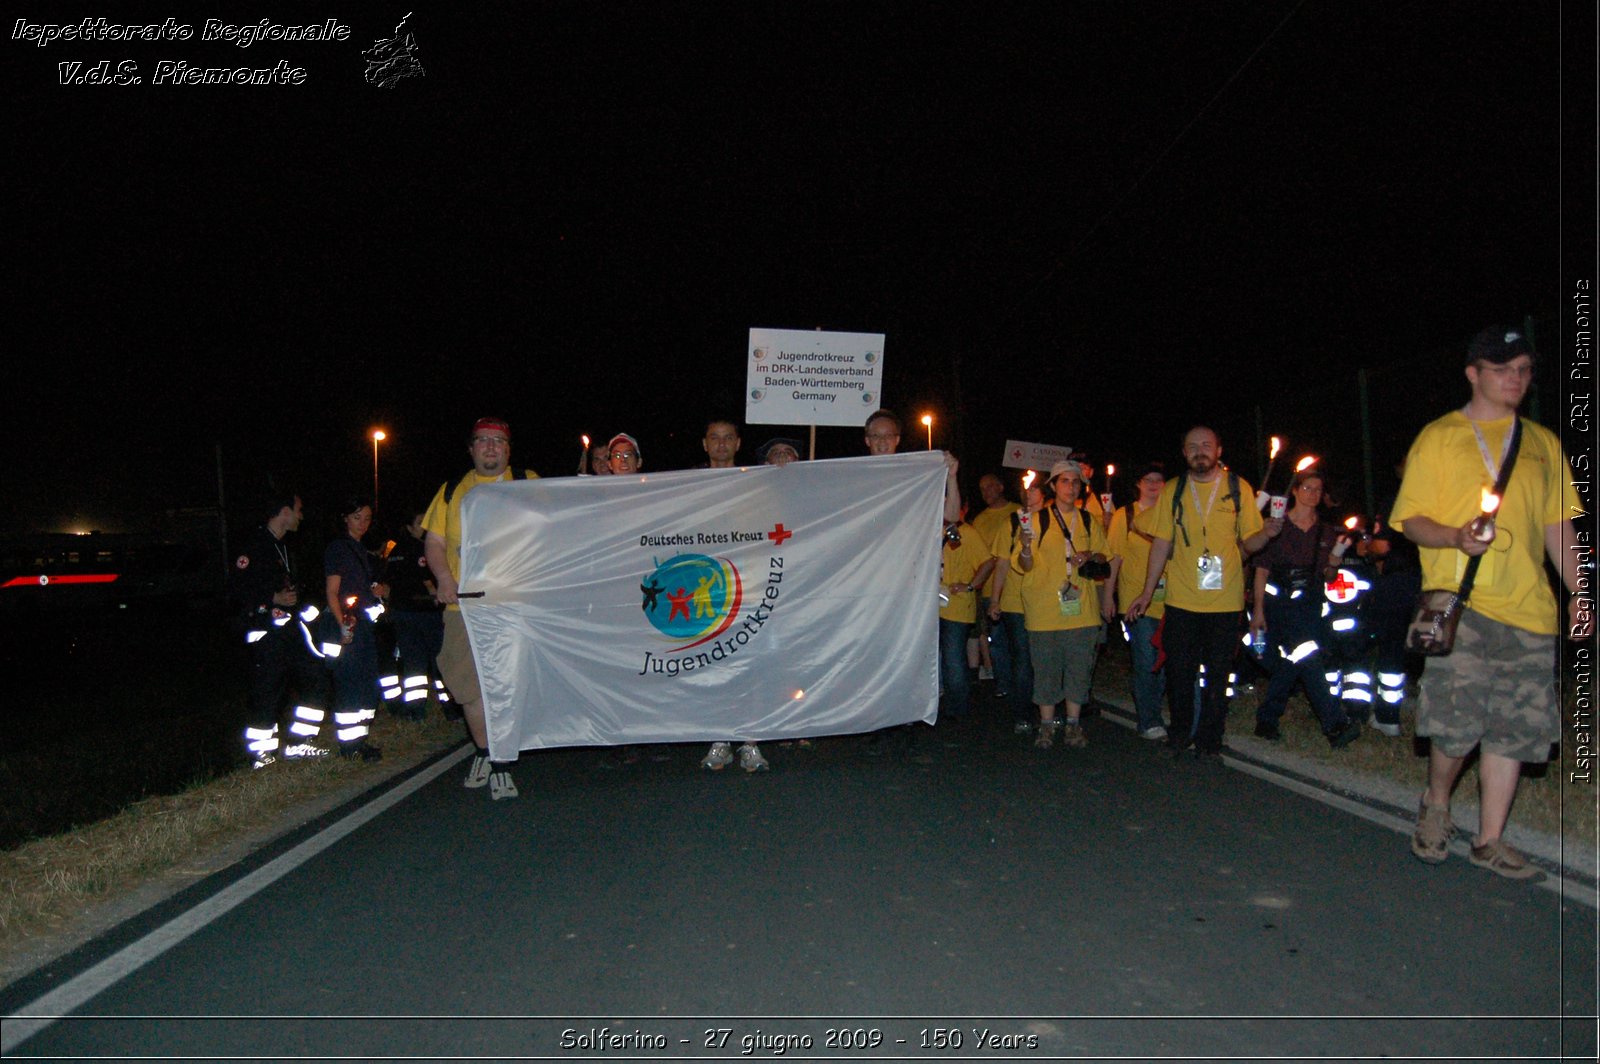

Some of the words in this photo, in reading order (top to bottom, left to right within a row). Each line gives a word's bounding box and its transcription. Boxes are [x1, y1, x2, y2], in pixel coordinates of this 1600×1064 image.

[777, 351, 855, 362] Jugendrotkreuz
[756, 363, 769, 372] im
[771, 364, 874, 376] DRK-Landesverband
[764, 377, 865, 391] Baden-Württemberg
[792, 390, 837, 403] Germany
[640, 534, 694, 546] Deutsches
[697, 532, 729, 544] Rotes
[731, 530, 764, 542] Kreuz
[638, 556, 784, 677] Jugendrotkreuz
